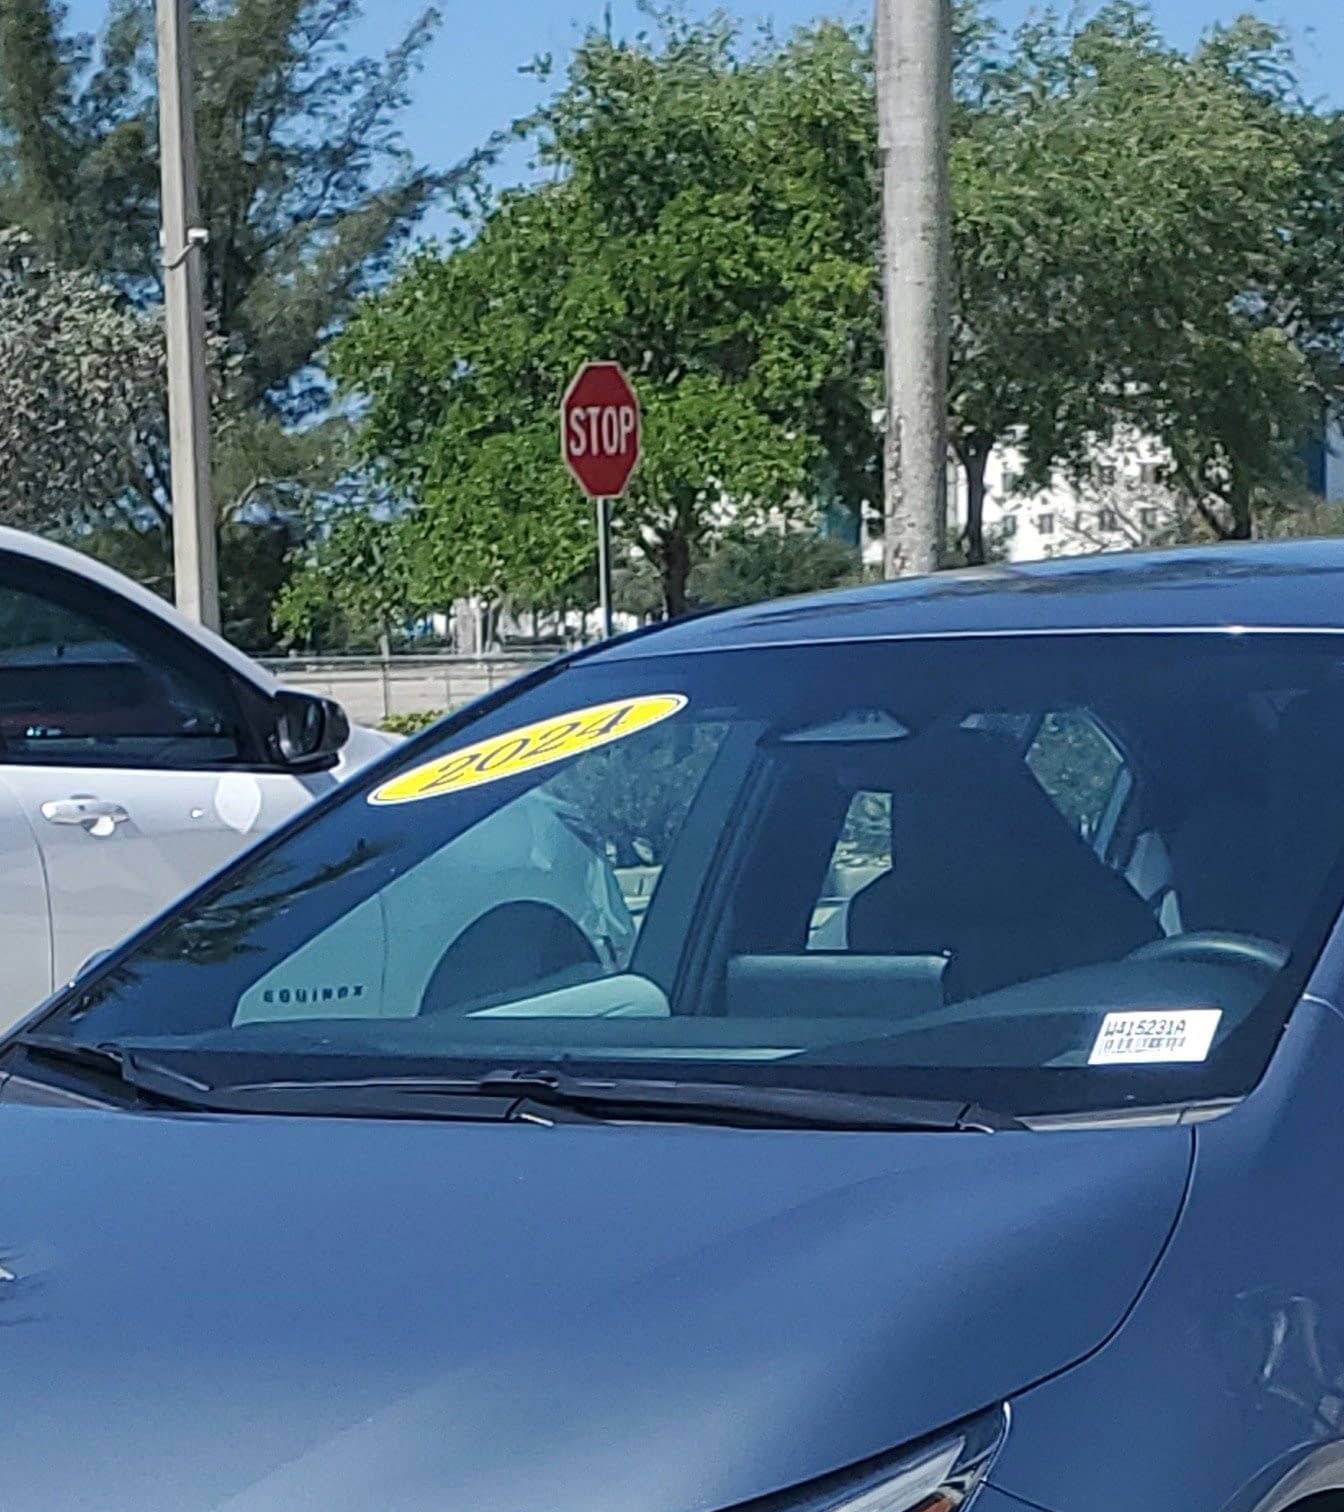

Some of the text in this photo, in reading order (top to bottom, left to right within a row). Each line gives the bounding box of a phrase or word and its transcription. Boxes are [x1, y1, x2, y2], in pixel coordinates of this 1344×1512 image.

[569, 405, 635, 456] STOP
[418, 704, 634, 793] 2024
[263, 985, 363, 1003] EQUINOX
